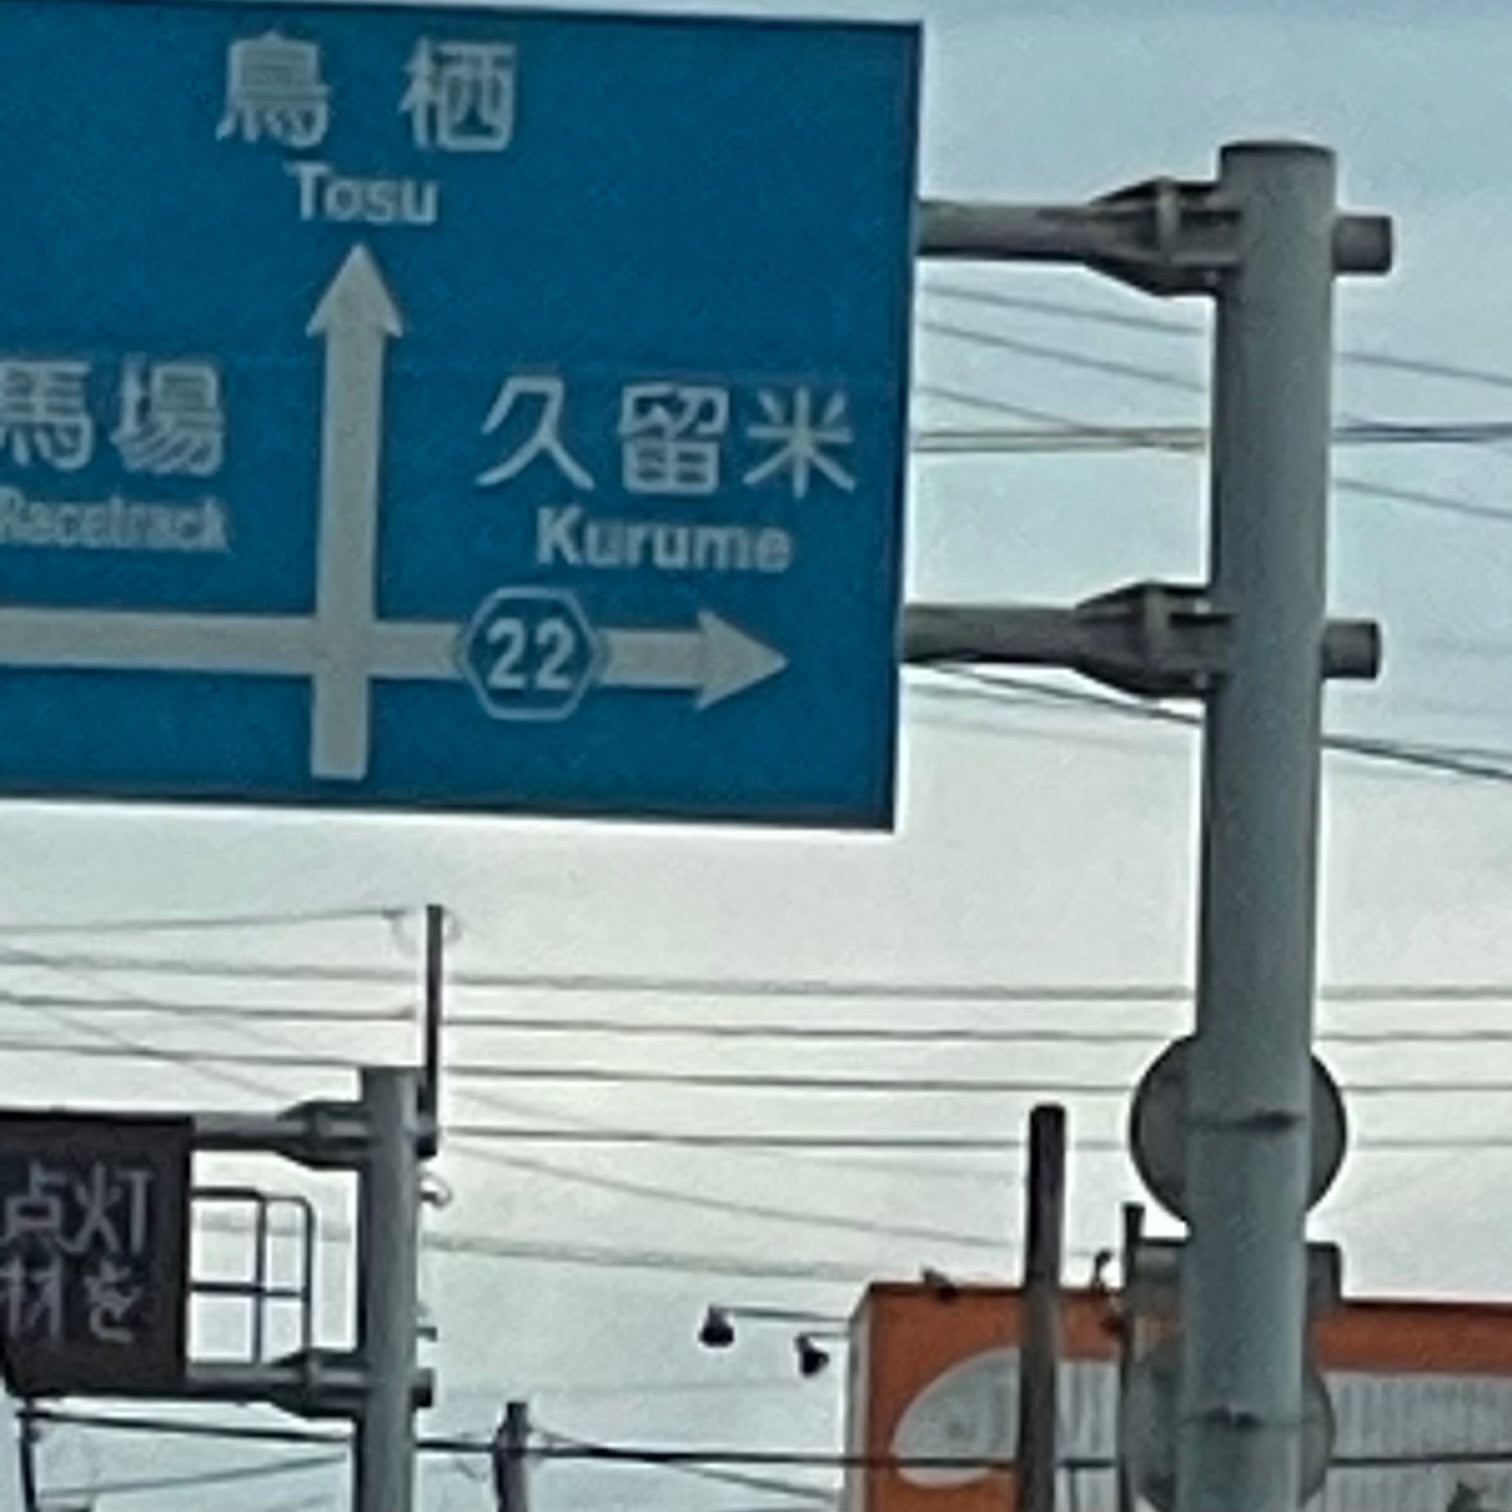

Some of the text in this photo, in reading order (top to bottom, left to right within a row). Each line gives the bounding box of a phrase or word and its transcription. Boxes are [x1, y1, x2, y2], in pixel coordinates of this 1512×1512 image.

[216, 31, 517, 152] 鳥栖
[284, 160, 440, 226] Tosu
[0, 352, 225, 476] 馬場
[476, 375, 858, 498] 久留米
[535, 504, 793, 574] Kurume
[485, 618, 574, 689] 22
